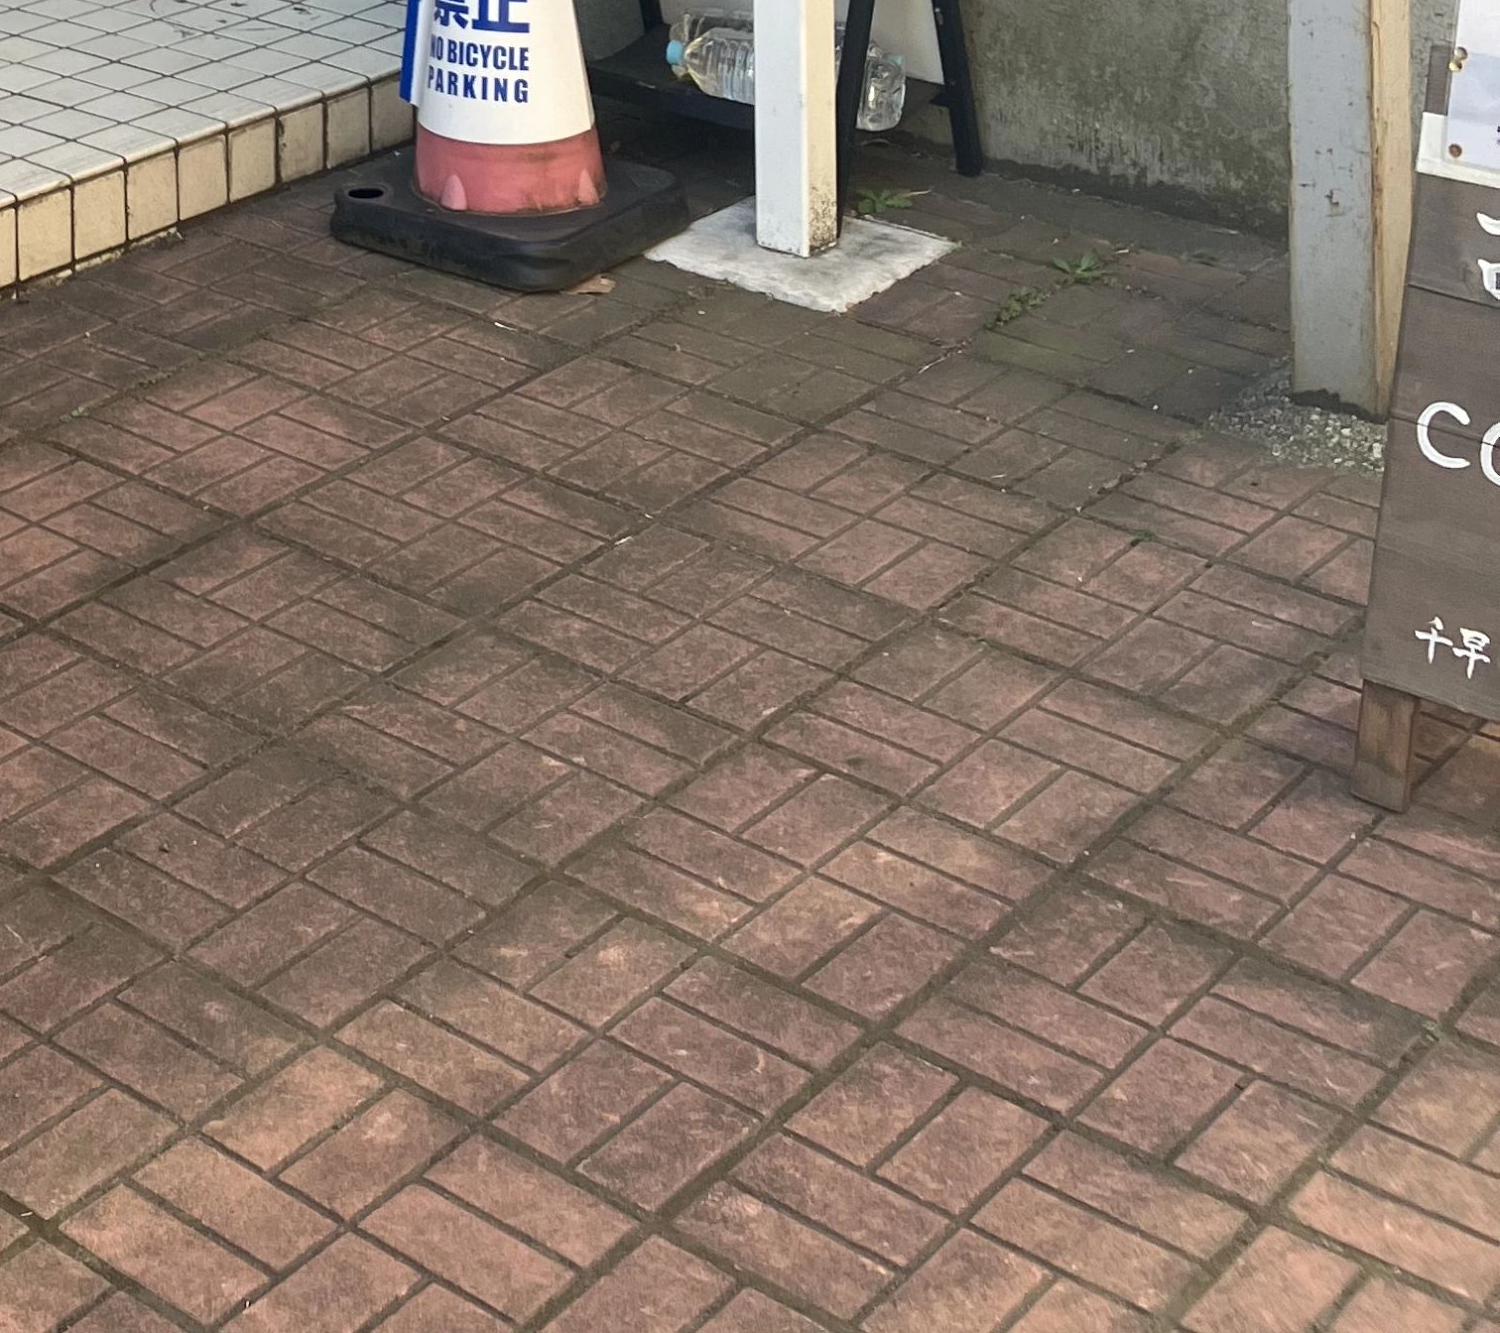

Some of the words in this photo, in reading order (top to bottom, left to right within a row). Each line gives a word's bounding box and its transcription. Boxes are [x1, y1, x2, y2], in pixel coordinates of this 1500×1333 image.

[447, 38, 530, 71] BICYCLE
[427, 65, 529, 103] PARKING
[1414, 616, 1491, 680] 千早
